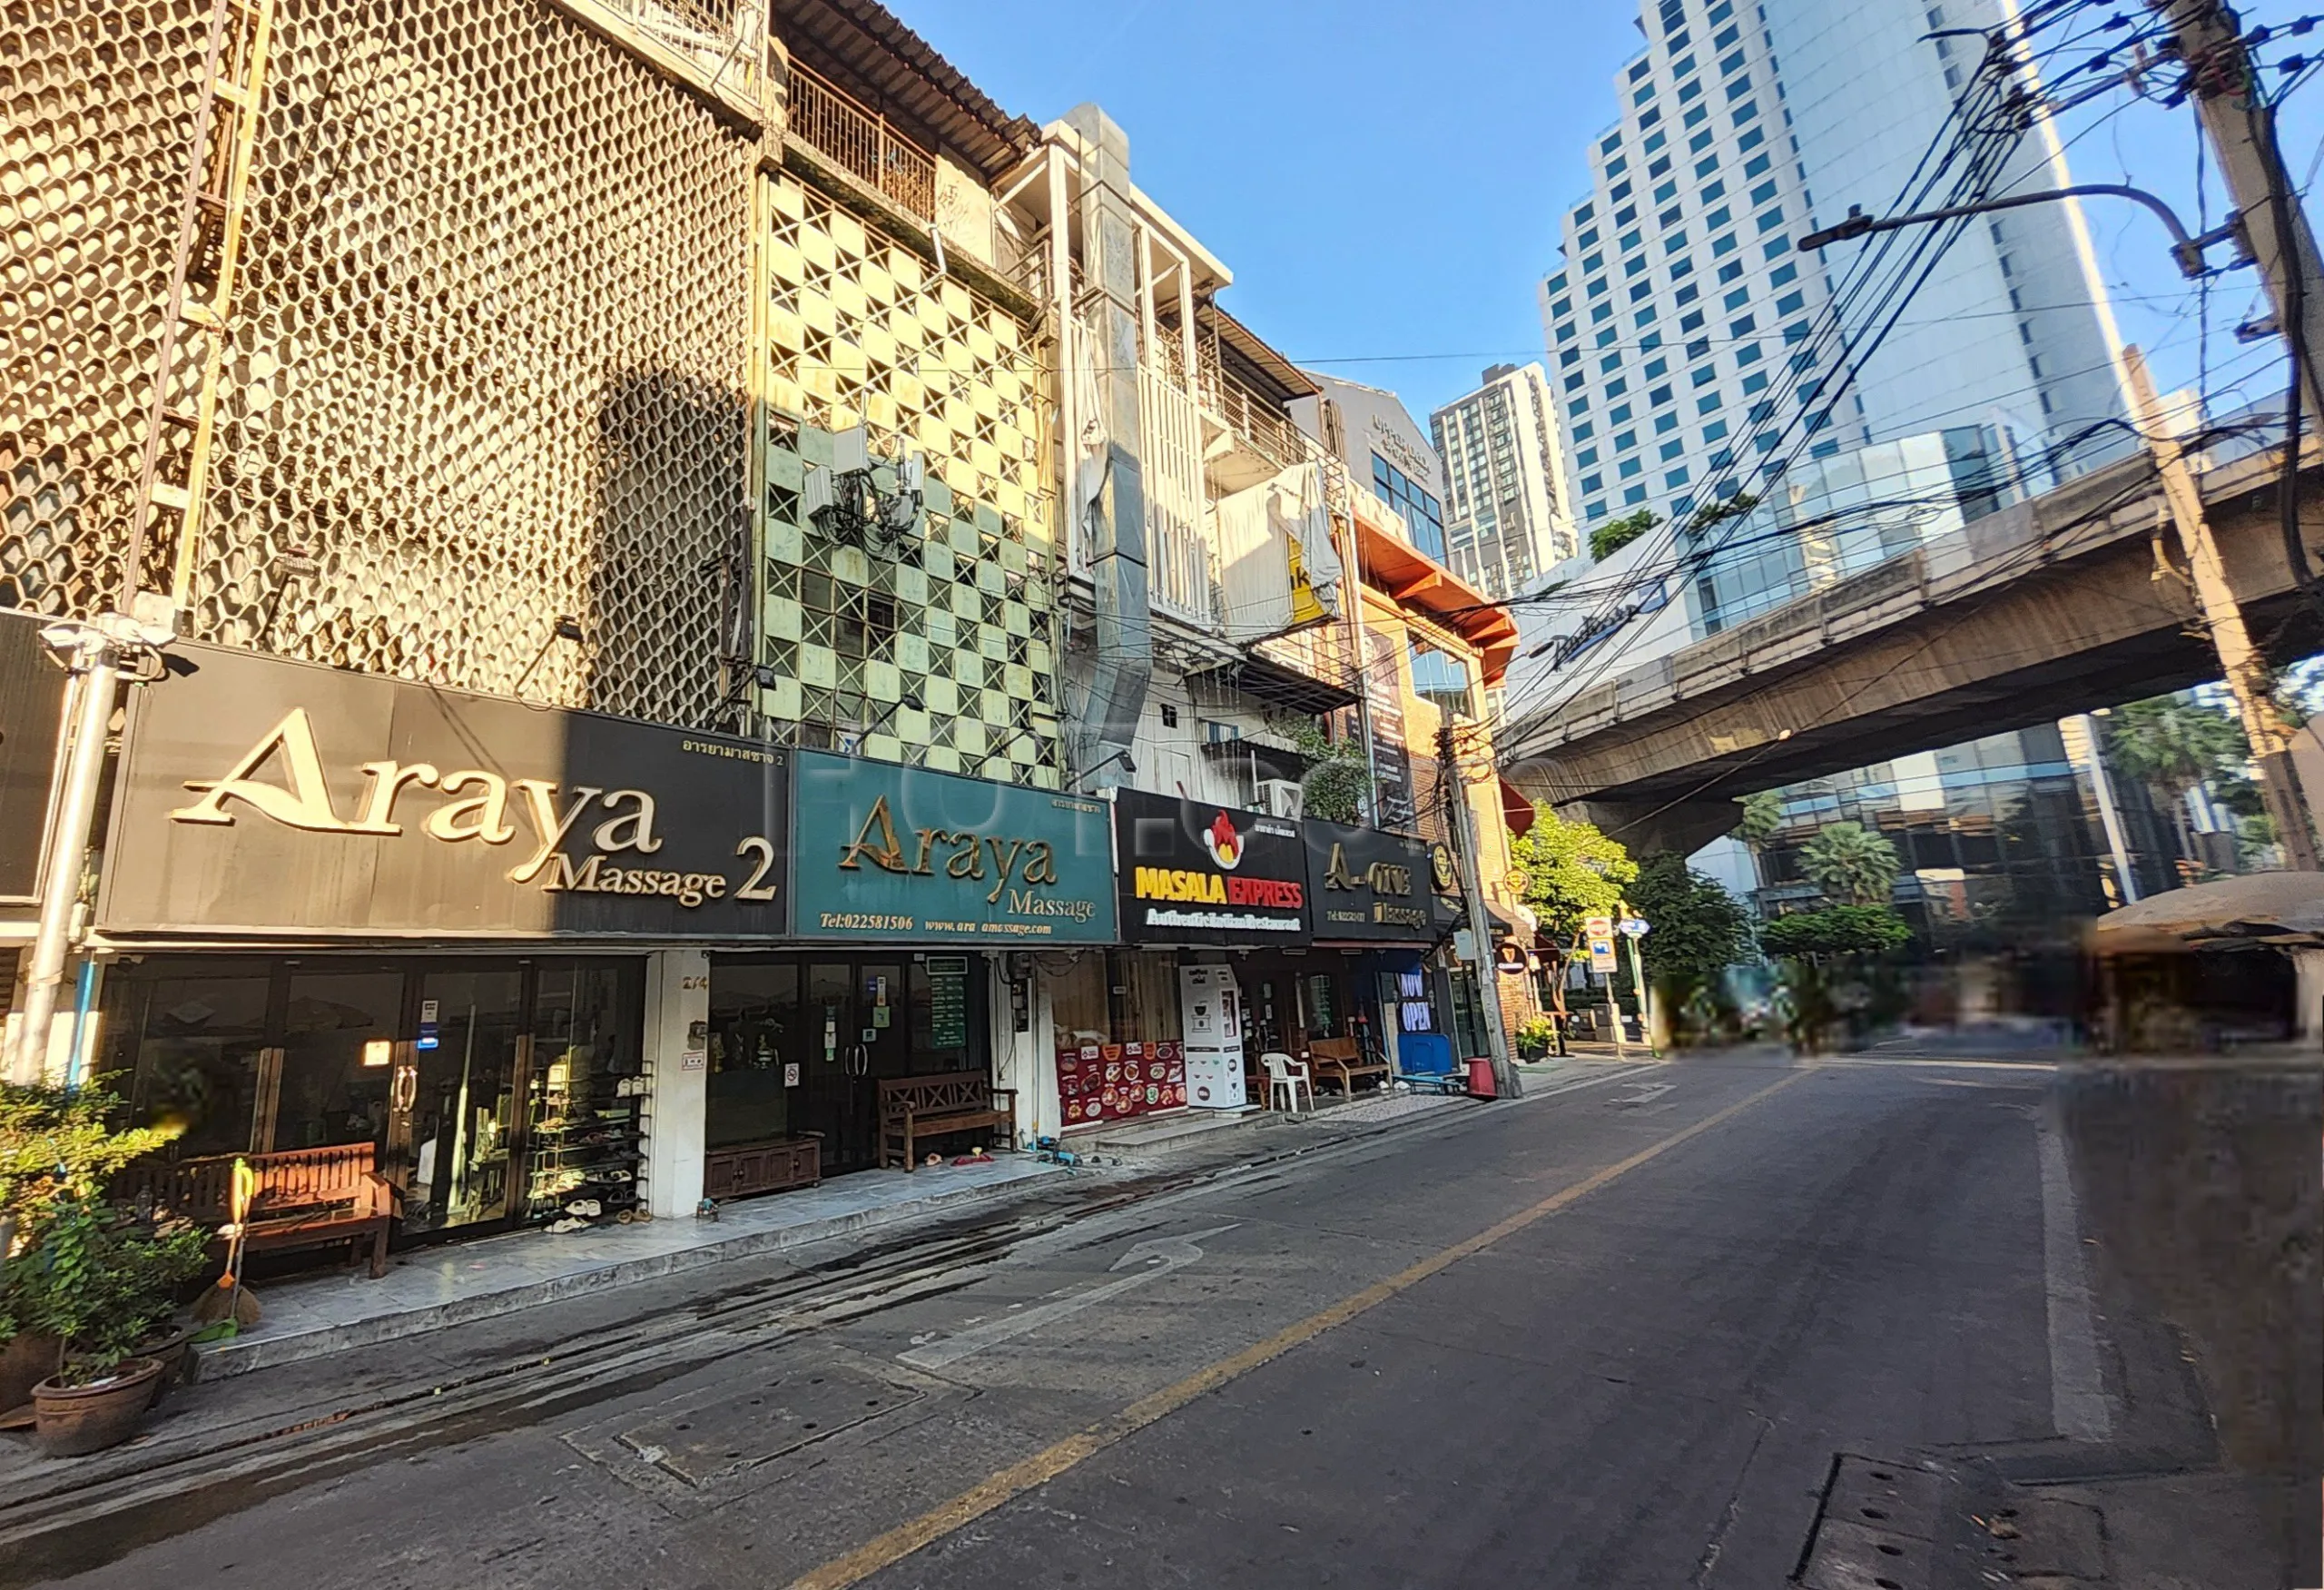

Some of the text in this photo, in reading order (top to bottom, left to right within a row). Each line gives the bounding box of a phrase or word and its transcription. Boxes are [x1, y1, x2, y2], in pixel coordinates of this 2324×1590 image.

[169, 706, 664, 884] Araya
[838, 794, 1059, 904] Araya
[541, 835, 778, 908] Massage 2
[1135, 866, 1304, 909] MASALA EXPRESS
[820, 913, 913, 931] Tel:022581506
[1007, 889, 1097, 923] Massage
[682, 976, 708, 991] 2/4
[1402, 1002, 1432, 1032] OPEN
